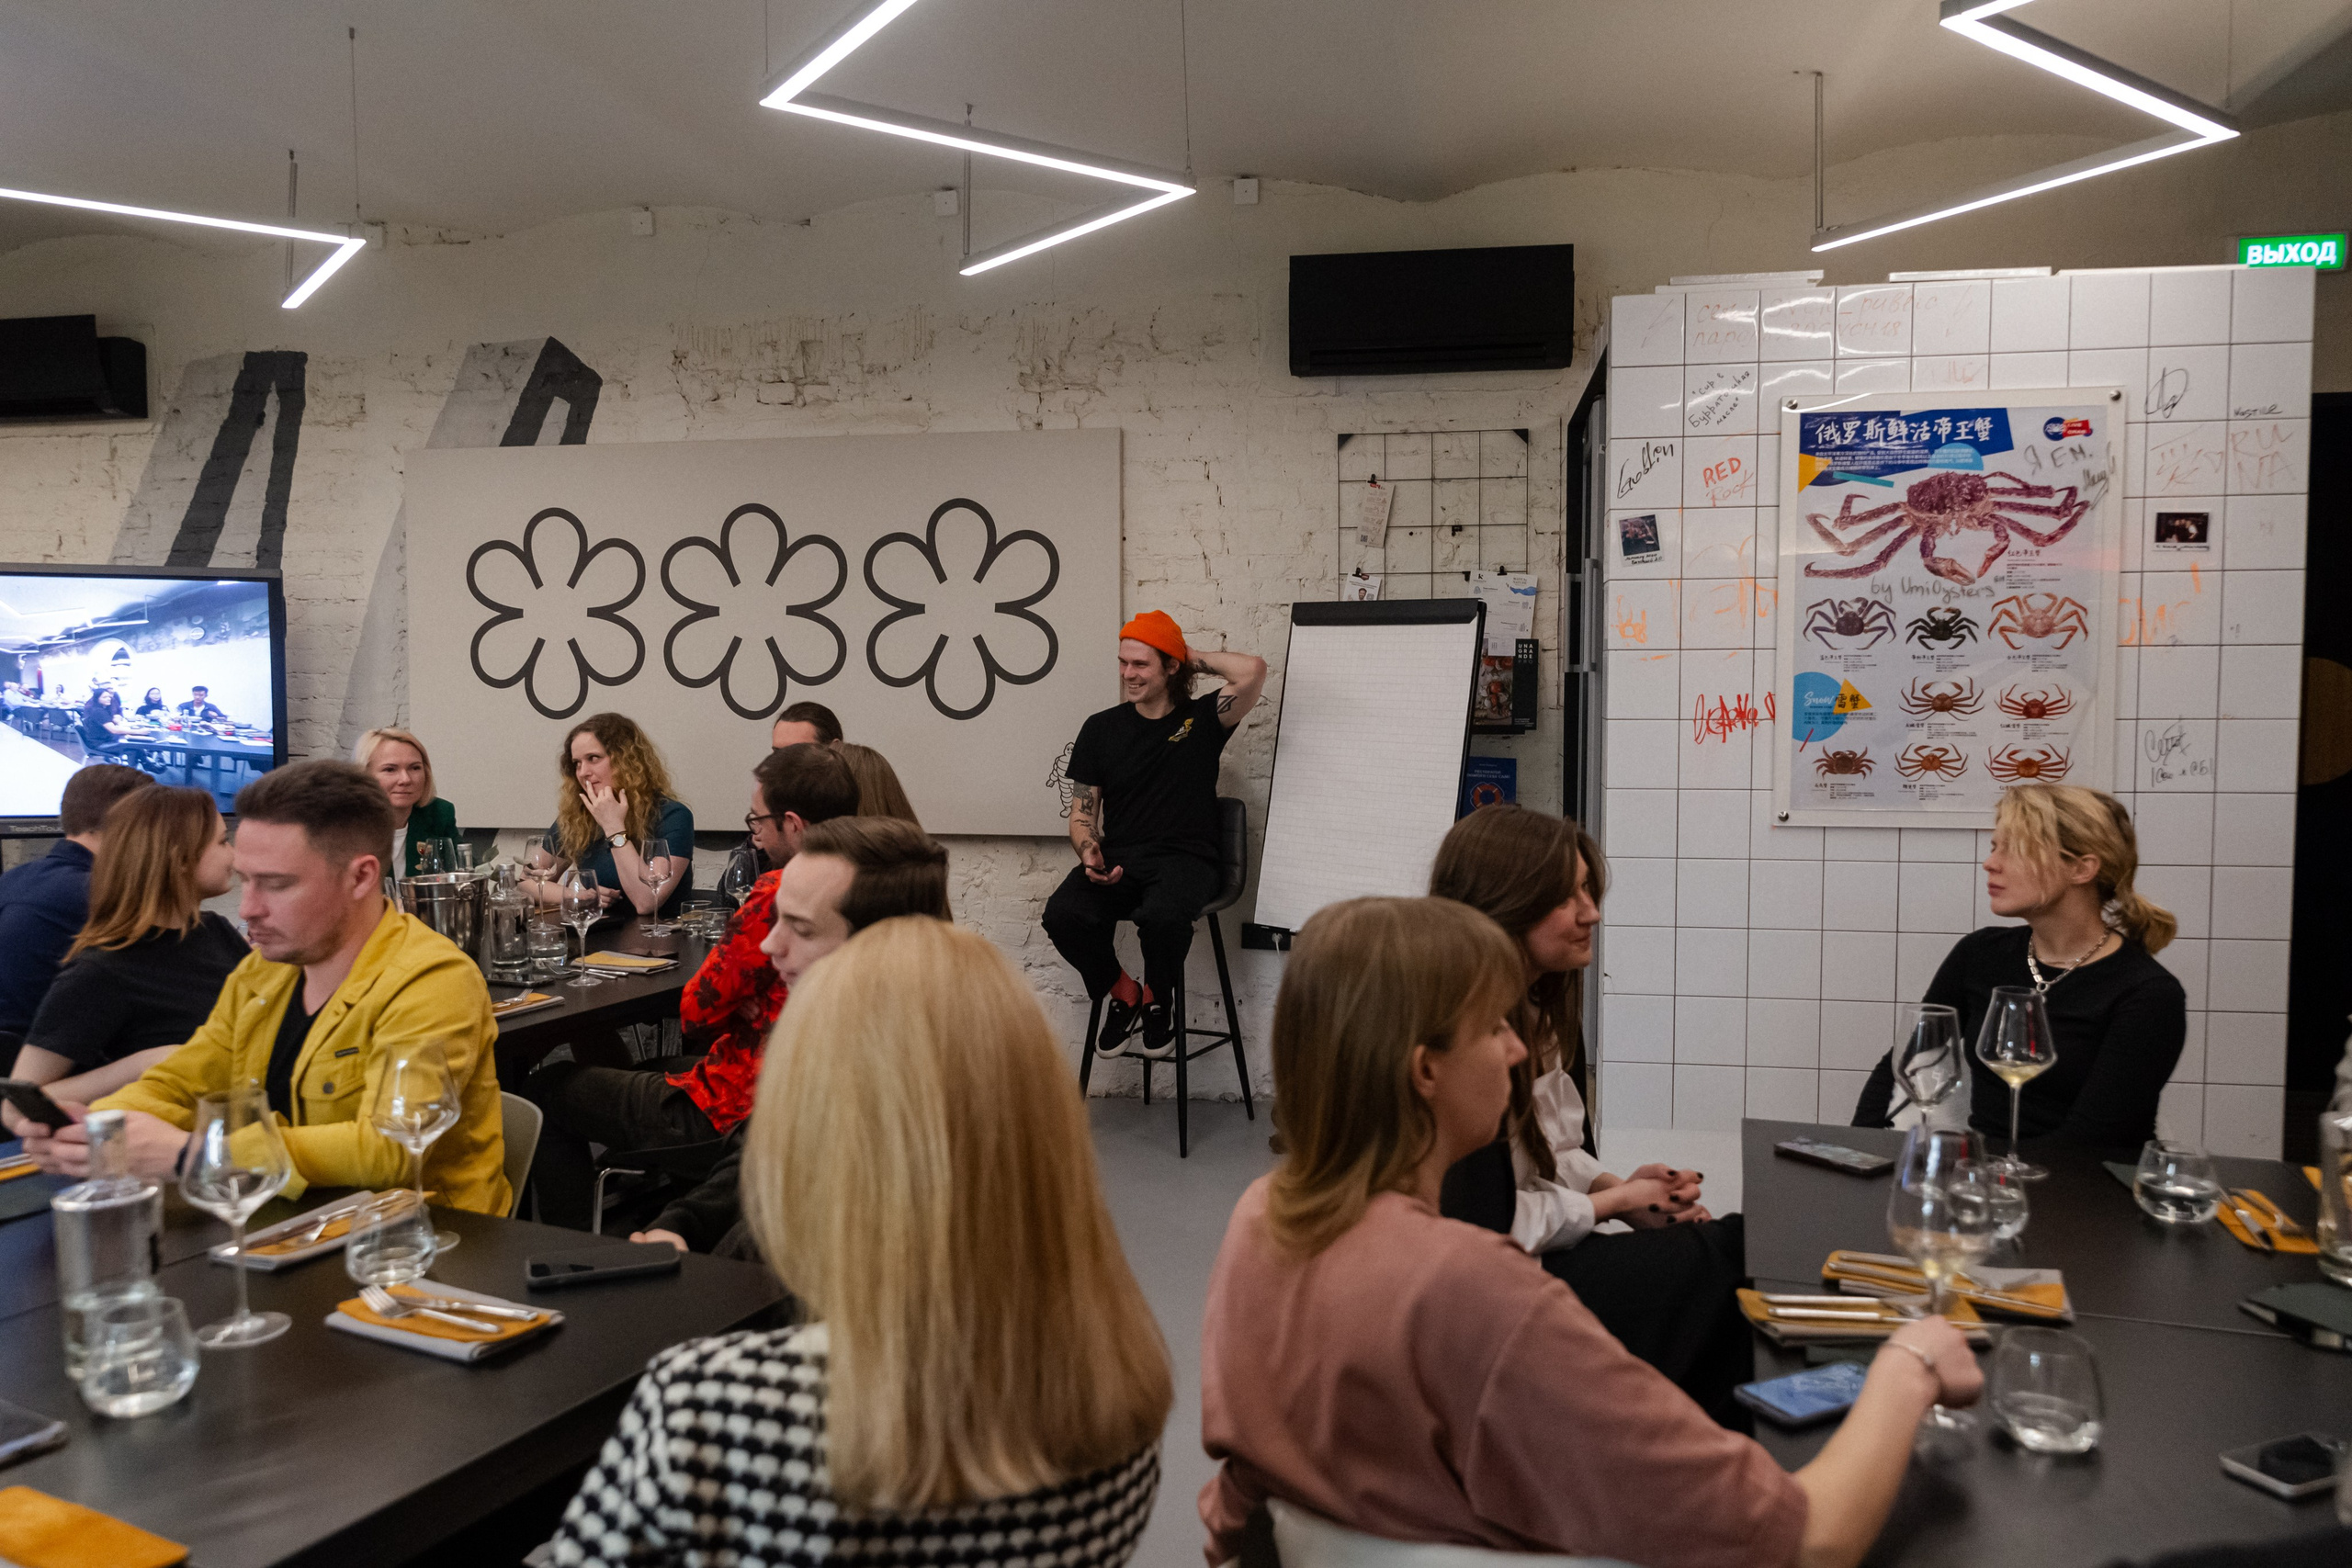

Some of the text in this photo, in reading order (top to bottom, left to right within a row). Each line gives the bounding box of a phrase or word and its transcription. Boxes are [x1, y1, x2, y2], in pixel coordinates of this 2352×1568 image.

[2246, 241, 2337, 266] ВЫХОД
[1815, 416, 1994, 445] 俄罗斯鲜活帝王蟹
[1702, 457, 1742, 489] RED
[1804, 691, 1835, 706] Snow
[1835, 693, 1861, 709] 雪蟹
